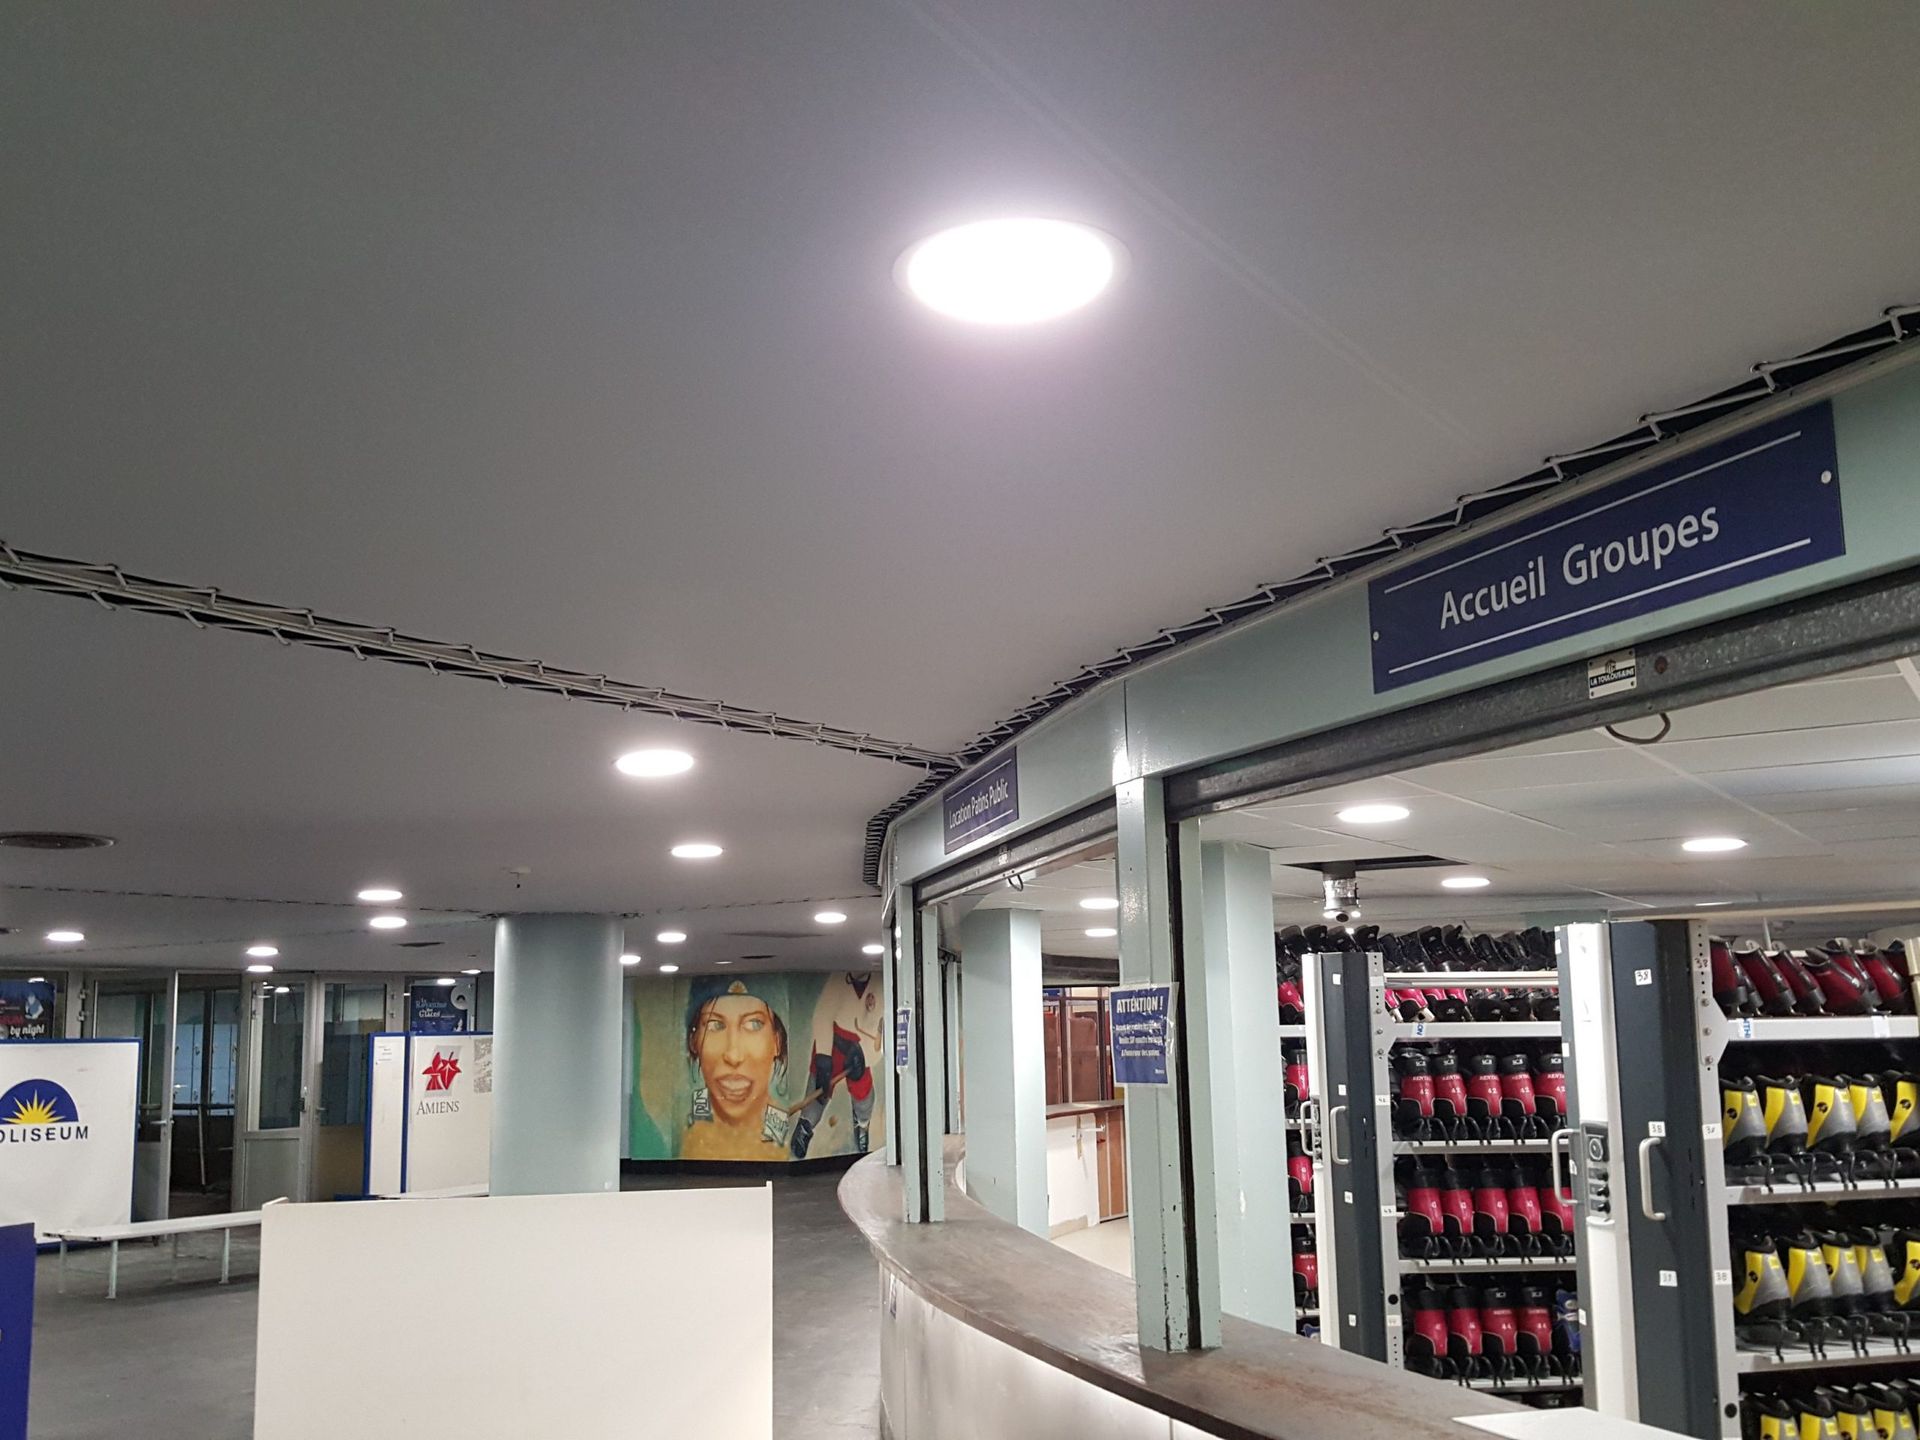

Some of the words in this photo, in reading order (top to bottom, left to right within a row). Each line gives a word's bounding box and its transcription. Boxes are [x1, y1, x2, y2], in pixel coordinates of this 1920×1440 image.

[1440, 556, 1546, 630] Accueil
[1563, 507, 1719, 586] Groupes
[1590, 677, 1598, 686] LA
[949, 803, 972, 829] Location
[971, 792, 989, 817] Patins
[989, 778, 1009, 808] Public
[1636, 971, 1649, 982] 38
[1116, 996, 1158, 1013] ATTENTION
[10, 1025, 21, 1038] by
[22, 1023, 45, 1037] night
[1451, 1086, 1461, 1094] 42
[416, 1101, 460, 1115] AMIENS
